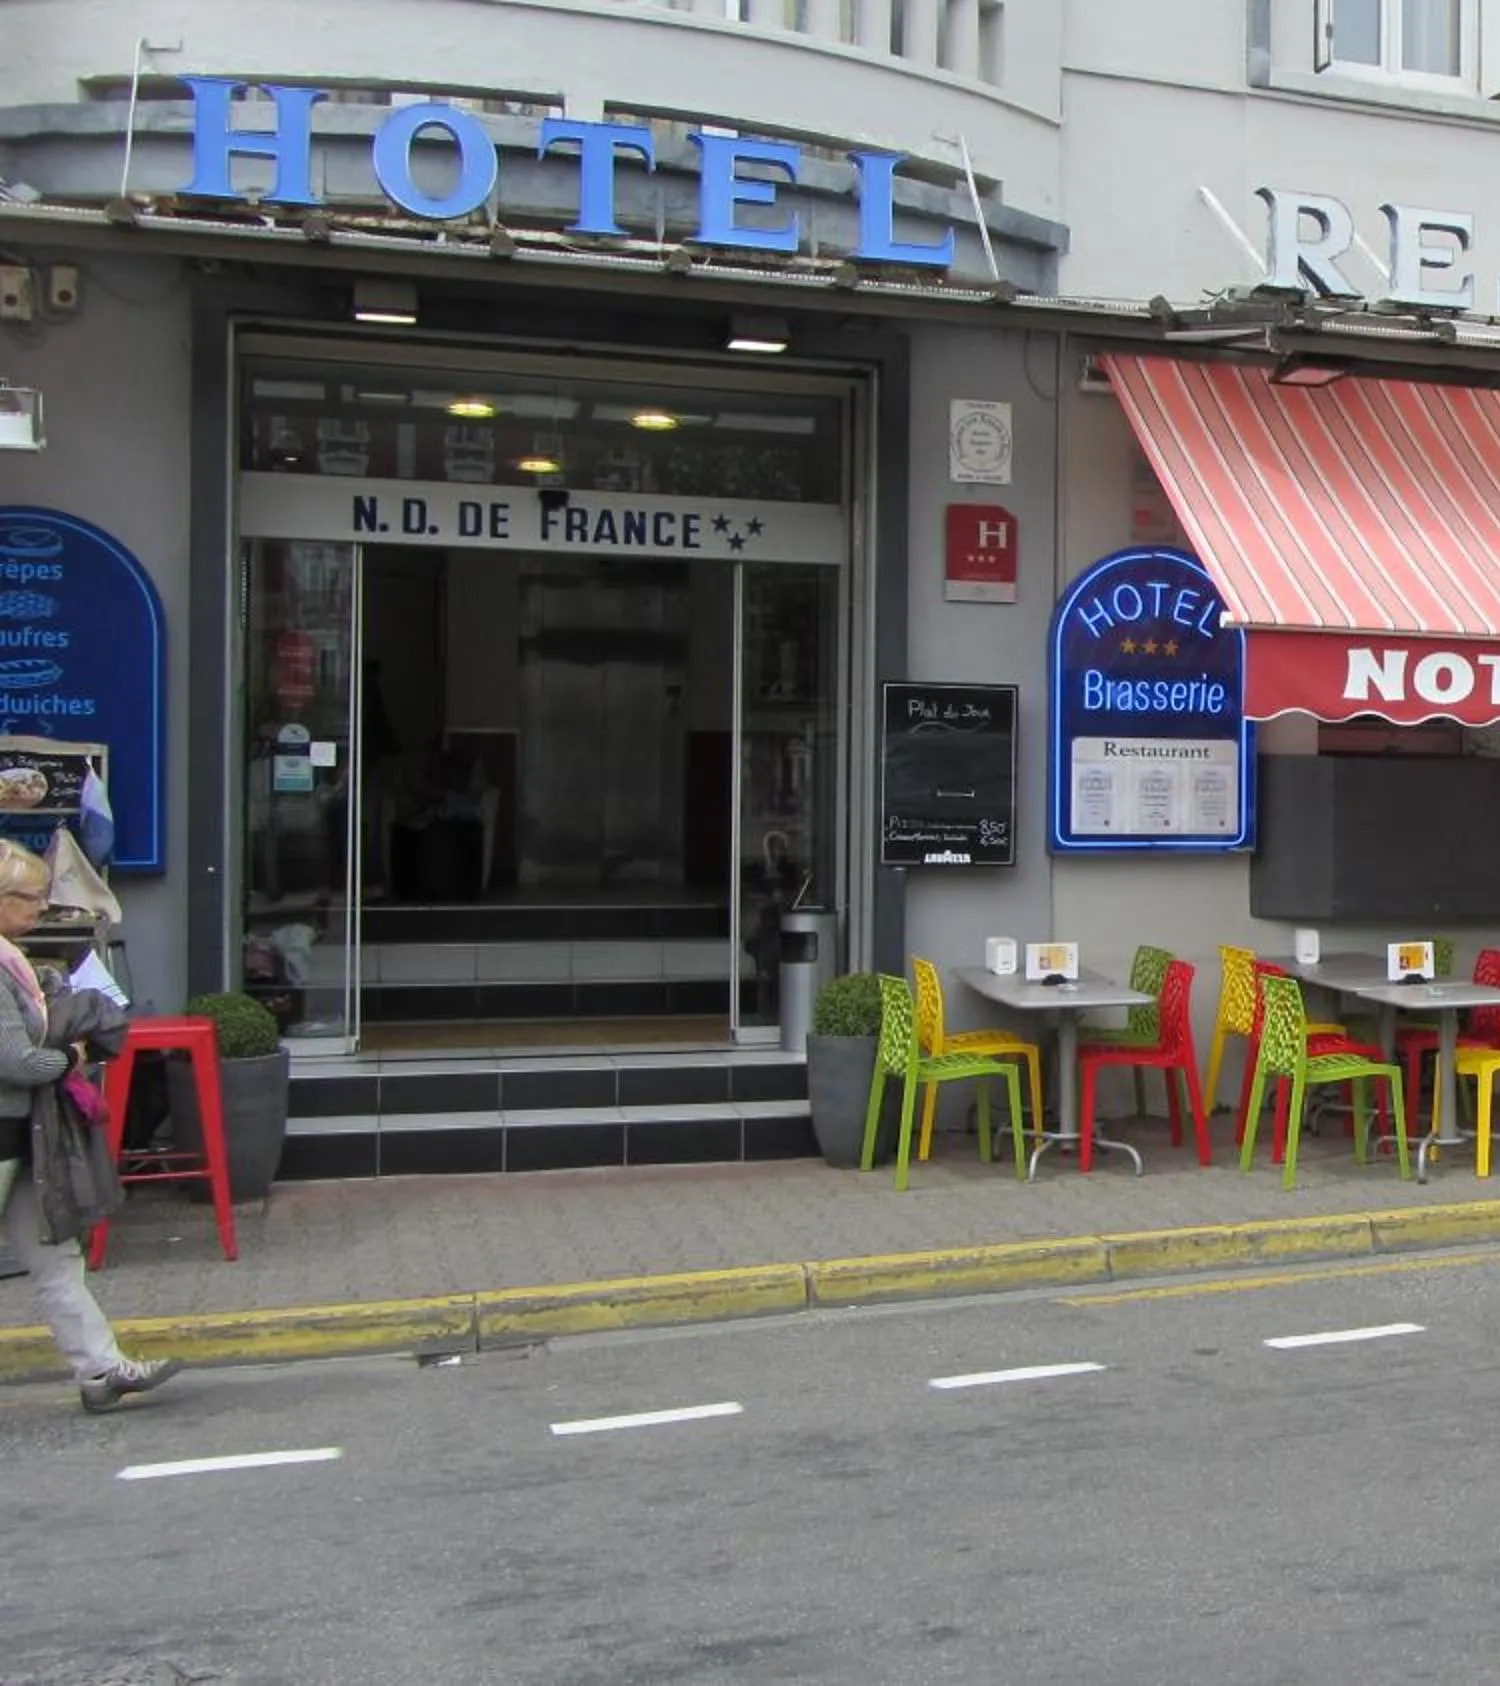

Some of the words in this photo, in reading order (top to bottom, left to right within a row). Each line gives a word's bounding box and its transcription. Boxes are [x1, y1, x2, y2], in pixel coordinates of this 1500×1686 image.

[178, 74, 956, 267] HOTEL
[458, 501, 510, 538] DE
[541, 507, 702, 548] FRANCE
[979, 520, 1007, 548] H
[1079, 583, 1215, 638] HOTEL
[1084, 669, 1225, 713] Brasserie
[1103, 740, 1211, 759] Restaurant
